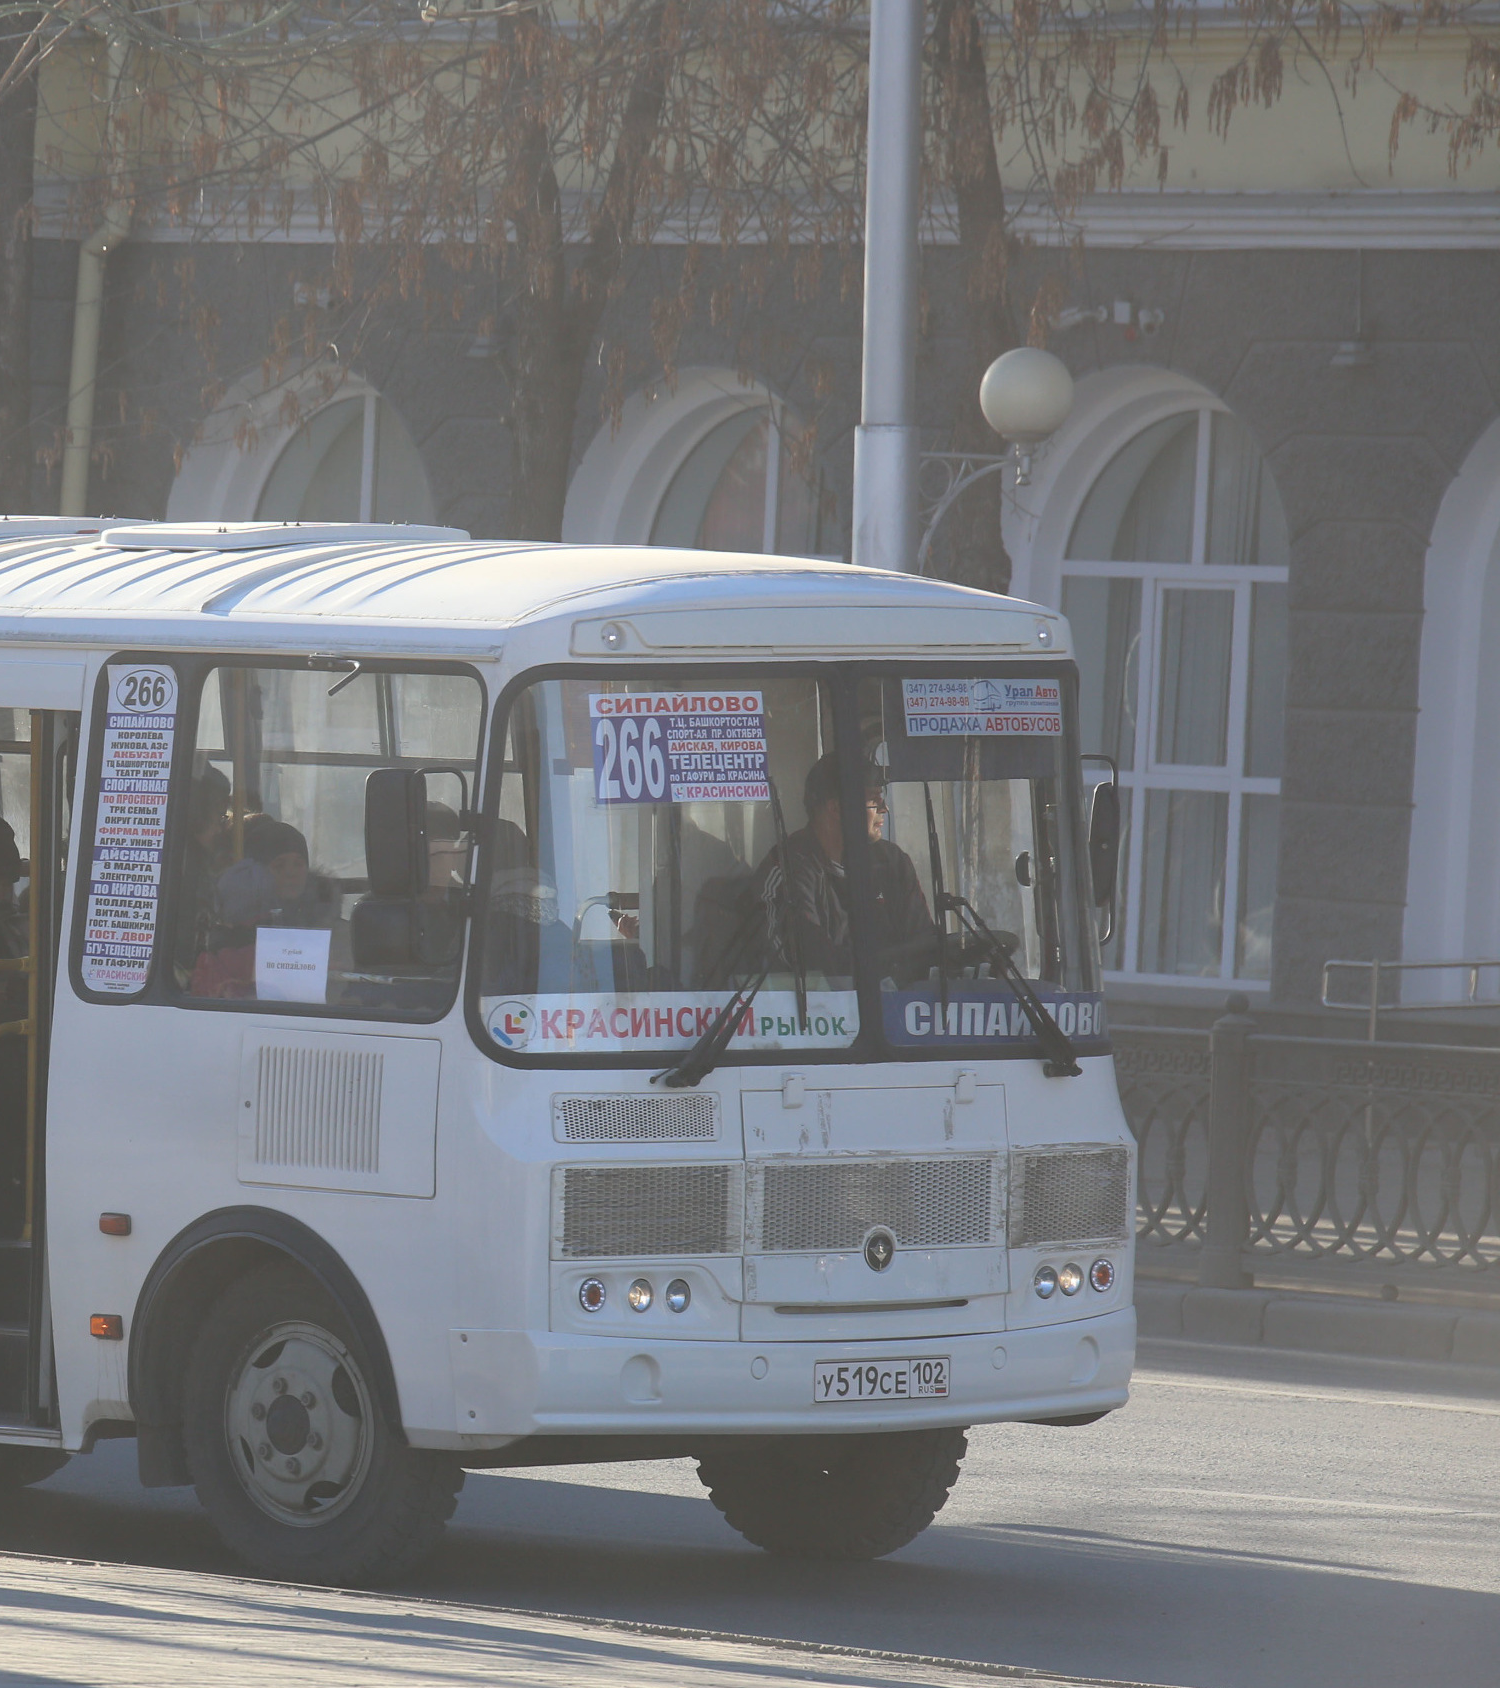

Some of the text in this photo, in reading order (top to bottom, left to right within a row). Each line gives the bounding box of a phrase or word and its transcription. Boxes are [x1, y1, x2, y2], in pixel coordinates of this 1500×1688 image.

[123, 676, 166, 707] 266
[906, 683, 968, 695] (347) 274-94-98
[1004, 685, 1058, 698] Урал Авто
[595, 694, 759, 715] СИПАЙЛОВО
[906, 696, 970, 709] (347) 274-98-98
[109, 714, 174, 729] СИПАЙЛОВО
[670, 717, 760, 729] Т.Ц. БАШКОРТОСТАН
[909, 717, 1061, 734] ПРОДАЖА АВТОБУСОВ
[667, 728, 763, 740] СПОРТ-АЯ ПР. ОКТЯБРЯ
[150, 742, 169, 750] АЗС
[671, 740, 764, 753] АЙСКАЯ, КИРОВА
[113, 751, 164, 760] АКБУЗАТ
[595, 718, 665, 800] 266
[106, 760, 170, 769] ТЦ БАШКОРТОСТАН
[669, 753, 765, 772] ТЕЛЕЦЕНТР
[116, 769, 160, 778] ТЕАТР НУР
[670, 770, 766, 782] по ГАФУРИ до КРАСИНА
[104, 779, 168, 793] СПОРТИВНАЯ
[687, 783, 768, 799] КРАСИНСКИЙ
[116, 794, 167, 806] ПРОСПЕКТУ
[110, 806, 158, 815] ТРК СЕМЬЯ
[104, 816, 161, 826] ОКРУГ ГАЛЛЕ
[99, 826, 165, 837] ФИРМА МИР
[99, 837, 162, 847] АГРАР. УНИВ-Т
[100, 848, 159, 862] АЙСКАЯ
[103, 861, 153, 872] 8 МАРТА
[94, 882, 157, 898] по КИРОВА
[95, 897, 153, 909] КОЛЛЕДЖ
[95, 908, 130, 919] ВИТАМ.
[89, 918, 155, 931] ГОСТ. БАШКИРИЯ
[89, 929, 153, 942] ГОСТ. ДВОР
[86, 942, 153, 958] БГУ-ТЕЛЕЦЕНТР
[106, 958, 145, 969] ГАФУРИ
[96, 969, 148, 981] КРАСИНСКИЙ
[760, 1015, 848, 1037] РЫНОК
[912, 1361, 944, 1385] 102
[918, 1385, 934, 1394] RUS
